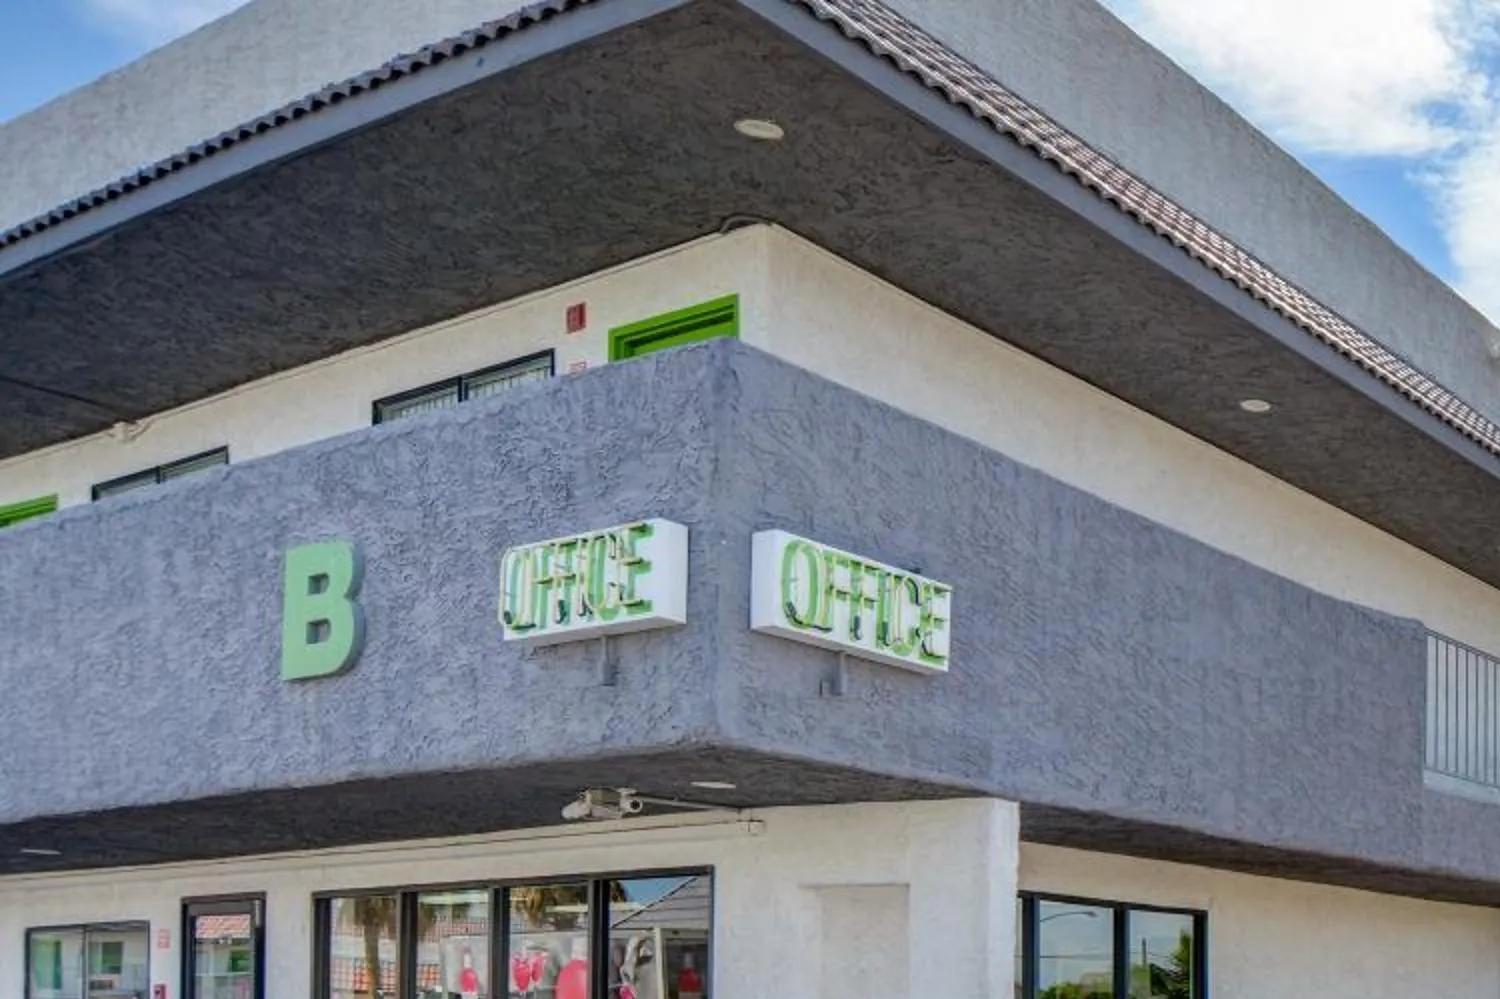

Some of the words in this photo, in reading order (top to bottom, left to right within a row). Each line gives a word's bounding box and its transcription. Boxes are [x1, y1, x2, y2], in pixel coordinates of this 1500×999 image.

[282, 539, 358, 681] B
[499, 521, 654, 634] OFFICE
[781, 538, 951, 666] OFFICE
